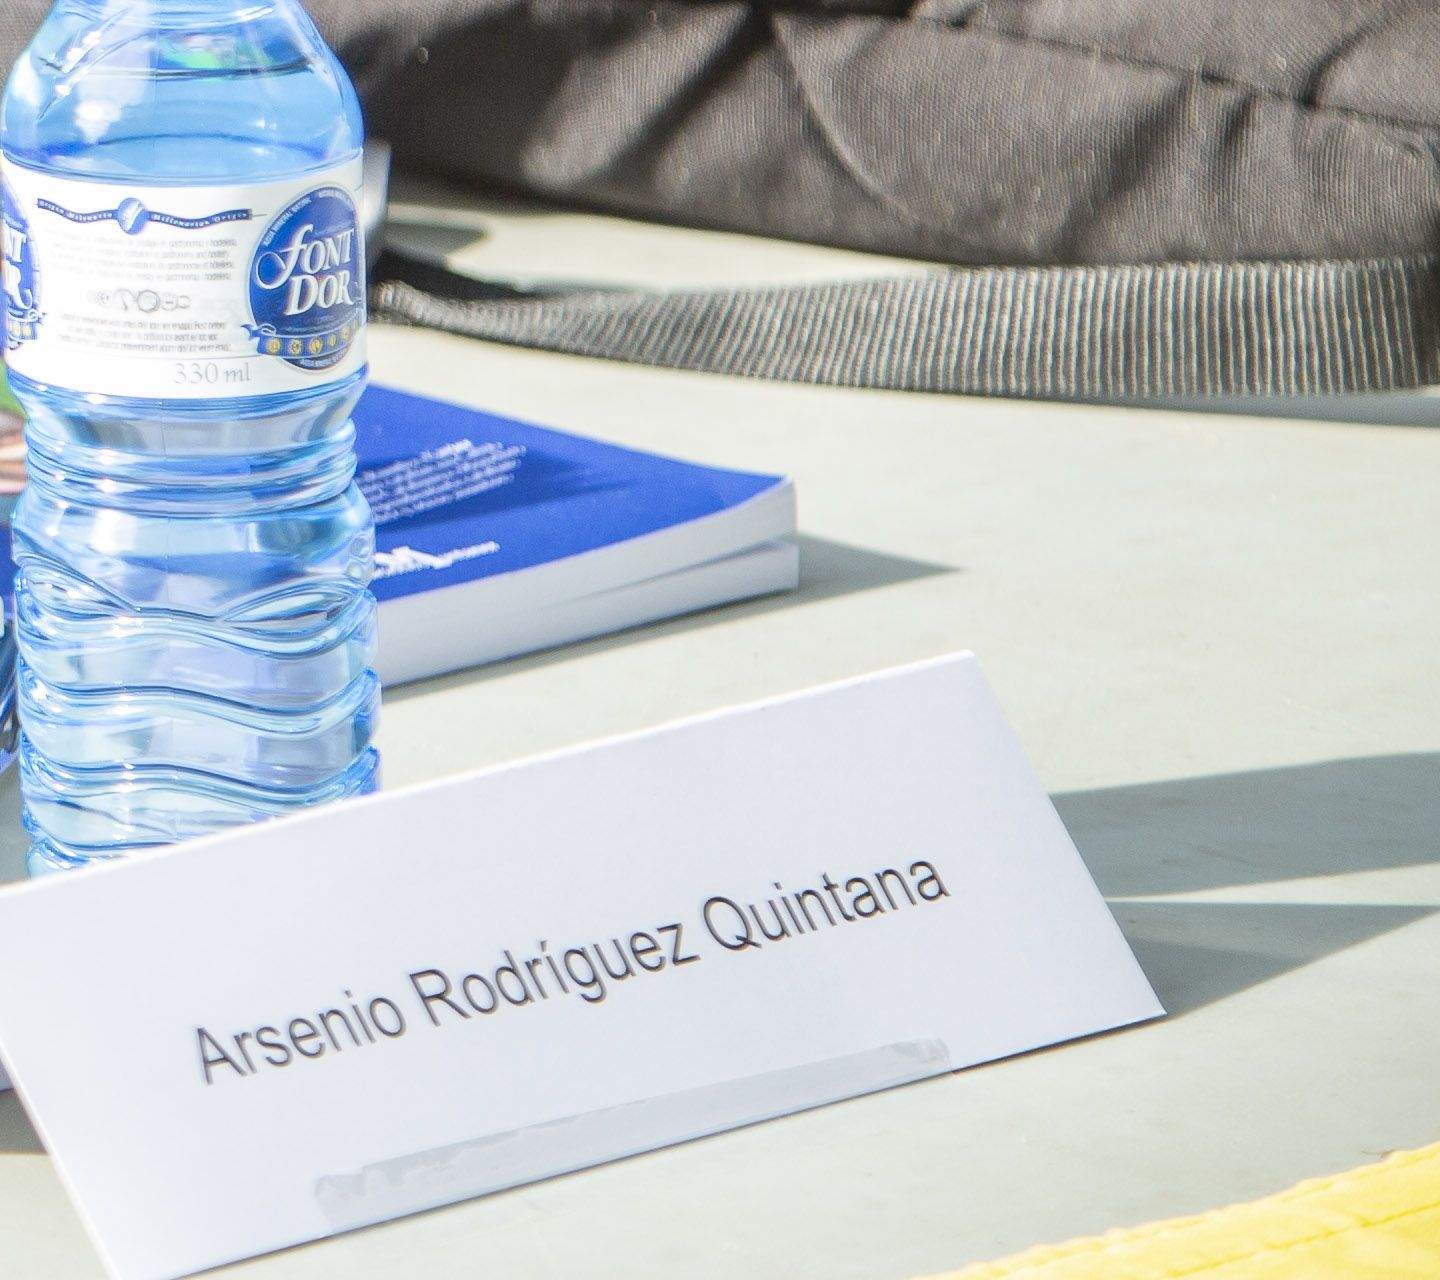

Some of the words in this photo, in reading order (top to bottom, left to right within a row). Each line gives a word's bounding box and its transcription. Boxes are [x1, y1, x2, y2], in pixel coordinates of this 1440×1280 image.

[175, 363, 218, 384] 330
[223, 361, 252, 382] ml
[195, 989, 406, 1086] Arsenio
[409, 920, 699, 1028] Rodríguez
[701, 858, 951, 952] Quintana
